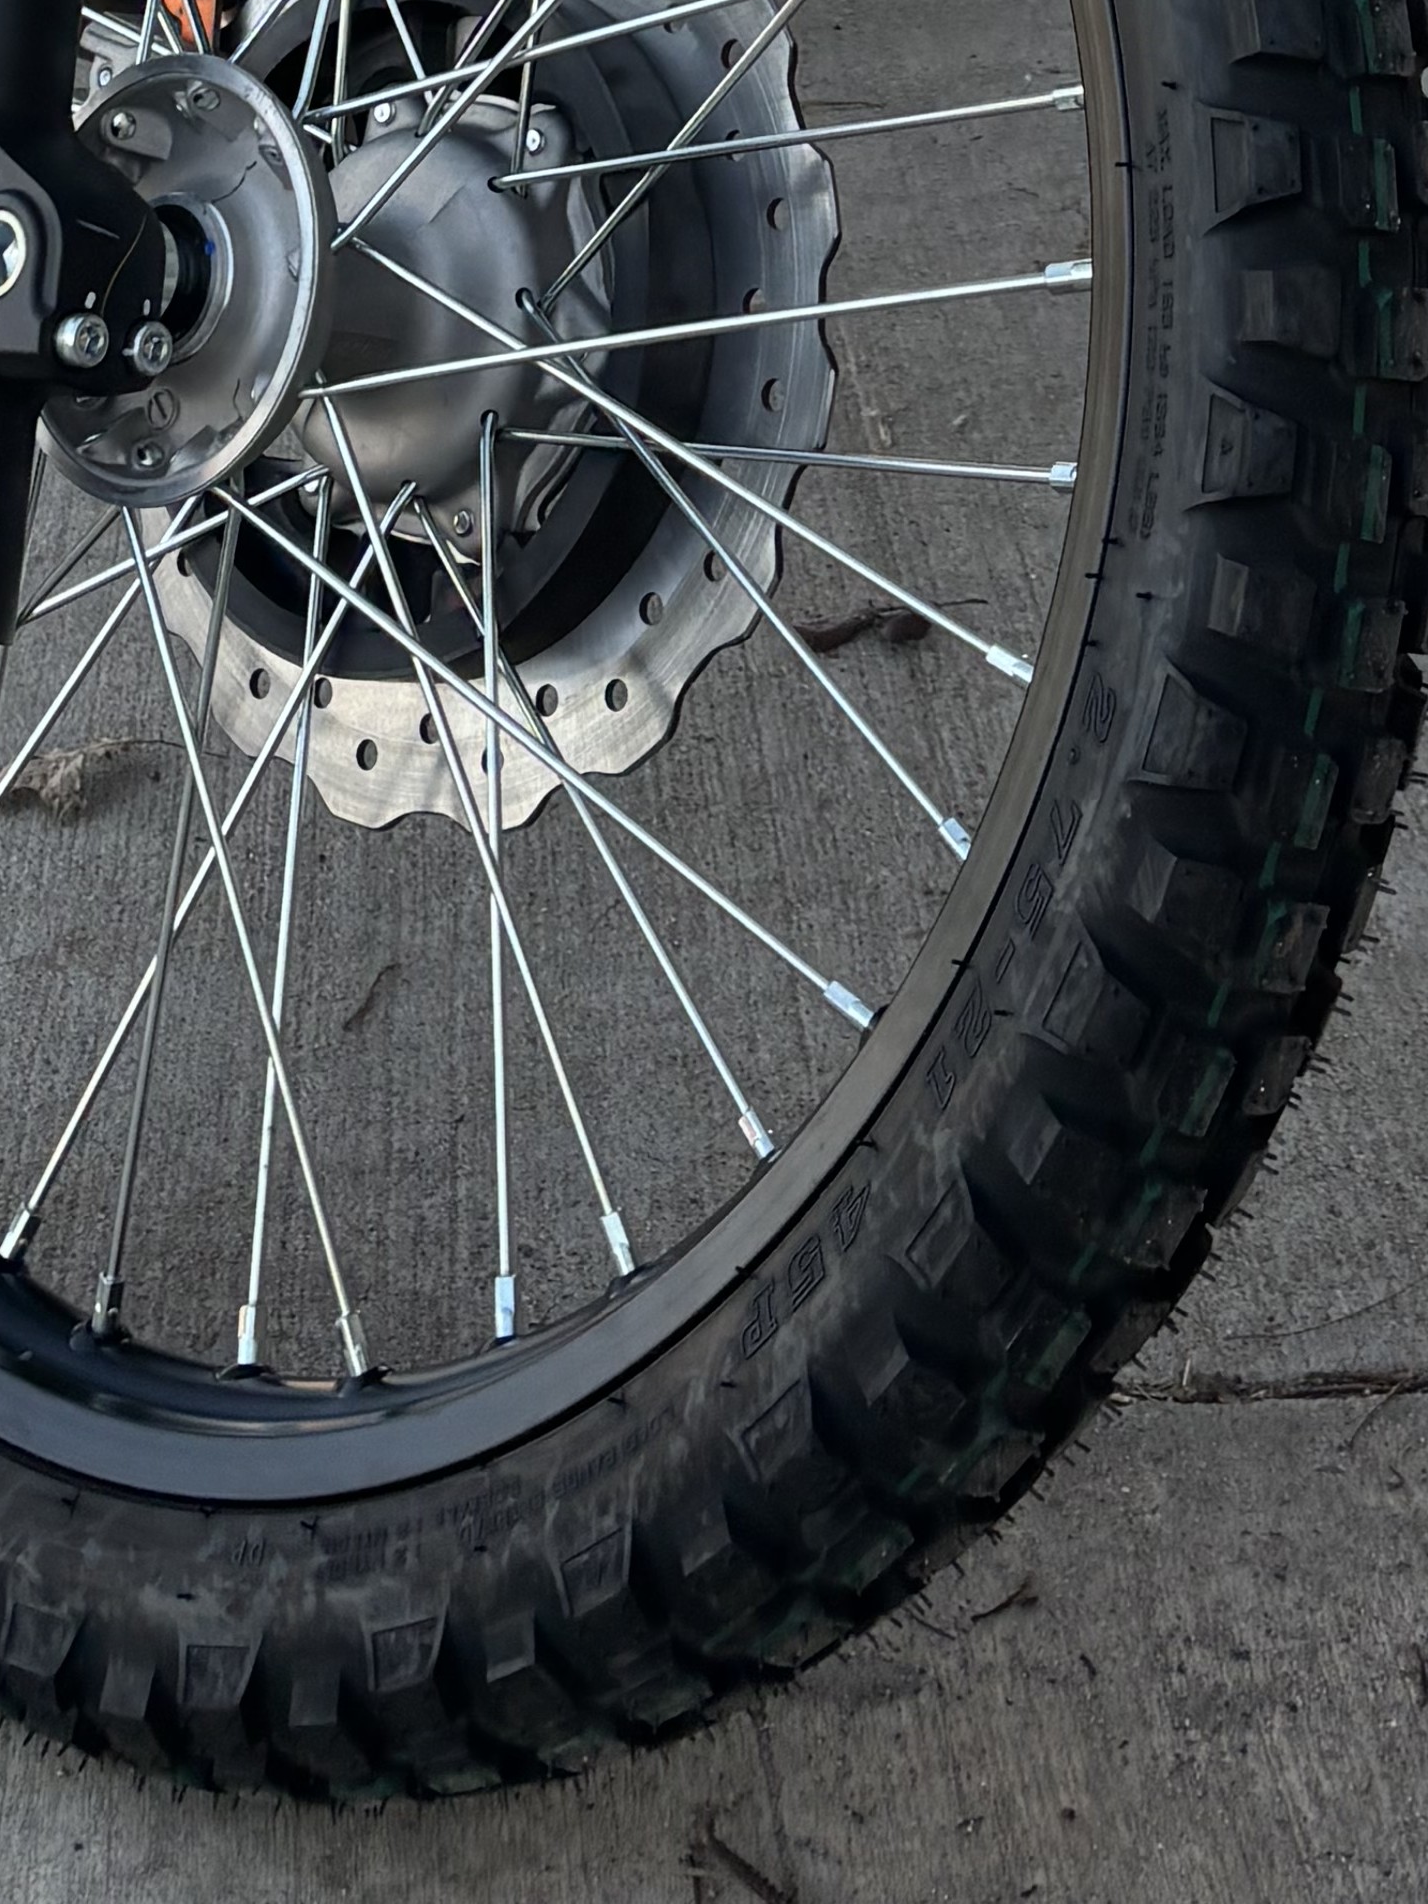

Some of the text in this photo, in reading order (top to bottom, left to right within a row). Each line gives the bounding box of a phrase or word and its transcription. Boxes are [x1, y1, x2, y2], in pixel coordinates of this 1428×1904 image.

[1161, 184, 1175, 258] LOAD
[743, 672, 1118, 1359] 2.75-21 45P
